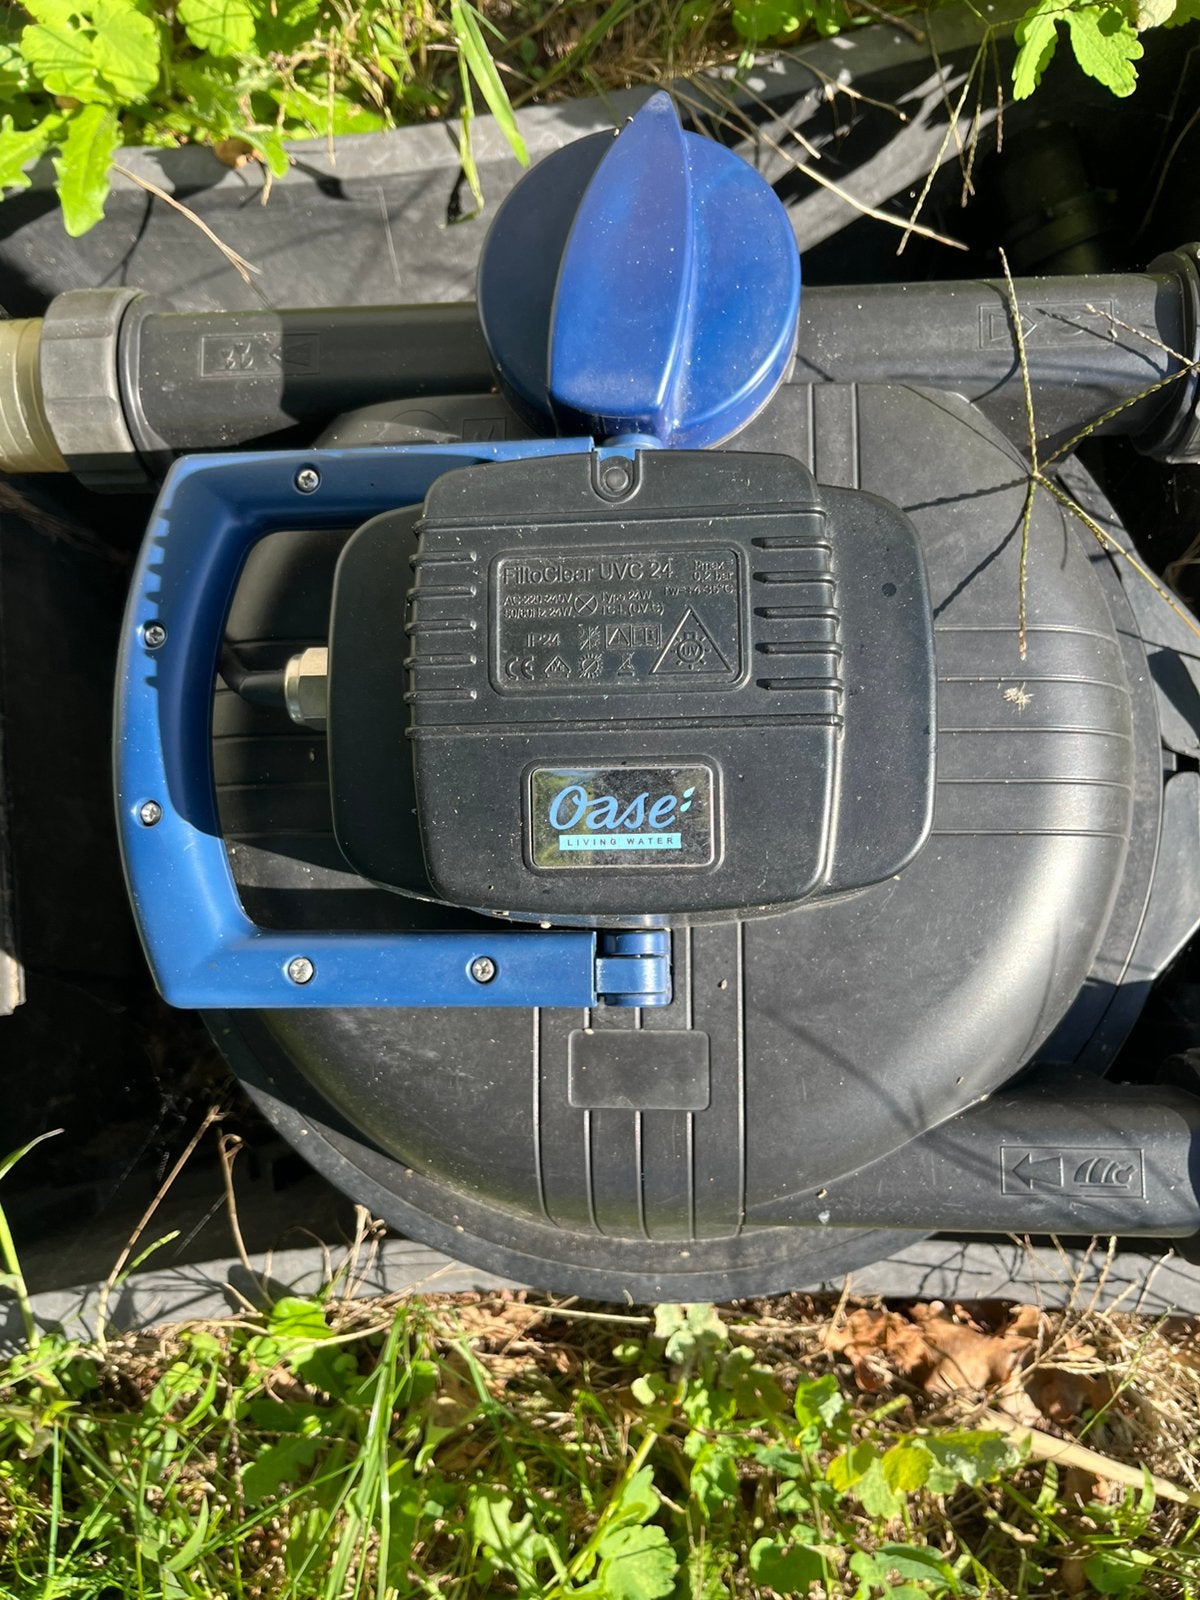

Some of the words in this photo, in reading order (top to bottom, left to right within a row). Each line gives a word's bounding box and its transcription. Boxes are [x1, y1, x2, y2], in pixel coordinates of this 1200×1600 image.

[502, 565, 595, 585] FiltoClear
[599, 561, 644, 581] UVC
[648, 560, 674, 580] 24
[692, 571, 712, 583] 0,2
[714, 570, 734, 582] bar
[628, 589, 653, 600] 24W
[548, 606, 574, 617] 24W
[526, 632, 561, 648] IP24
[683, 645, 700, 657] UV
[505, 655, 535, 681] CE
[549, 785, 678, 831] Oase
[567, 837, 617, 847] LIVING
[626, 836, 674, 846] WATER
